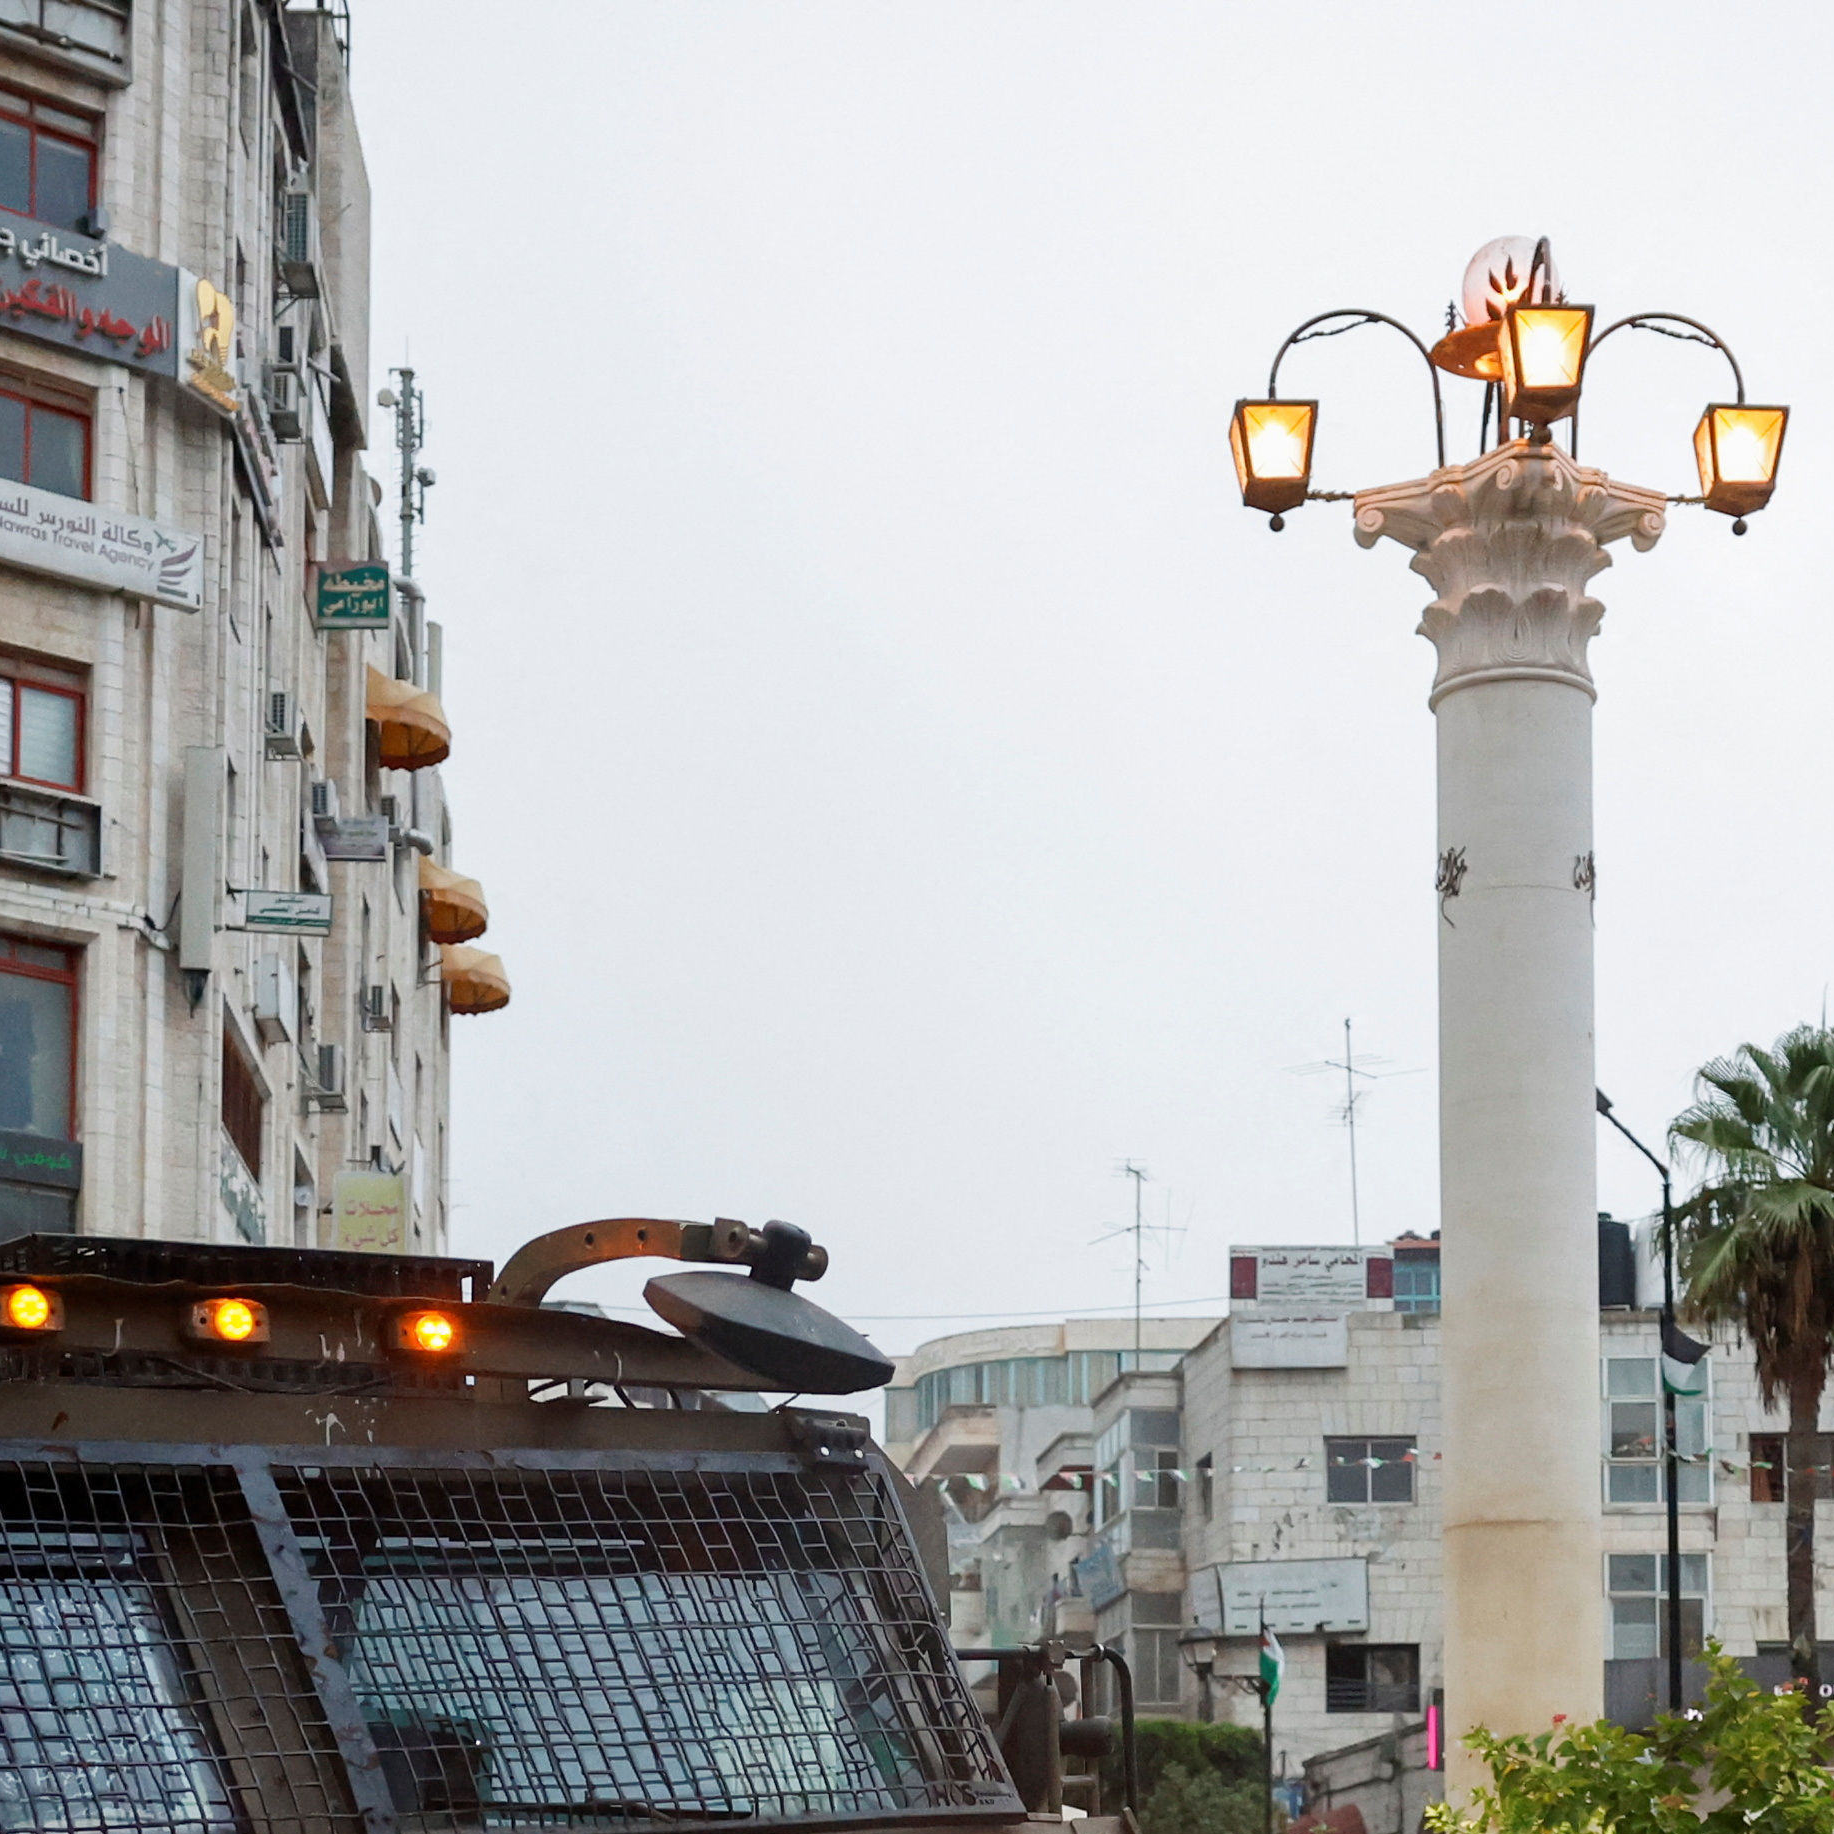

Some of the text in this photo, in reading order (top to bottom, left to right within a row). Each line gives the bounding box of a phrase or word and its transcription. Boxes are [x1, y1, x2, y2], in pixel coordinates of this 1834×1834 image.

[20, 232, 110, 278] أخصائي
[36, 510, 96, 538] النورس
[102, 520, 154, 556] وكالة
[51, 528, 95, 556] Travel
[98, 543, 155, 573] Agency
